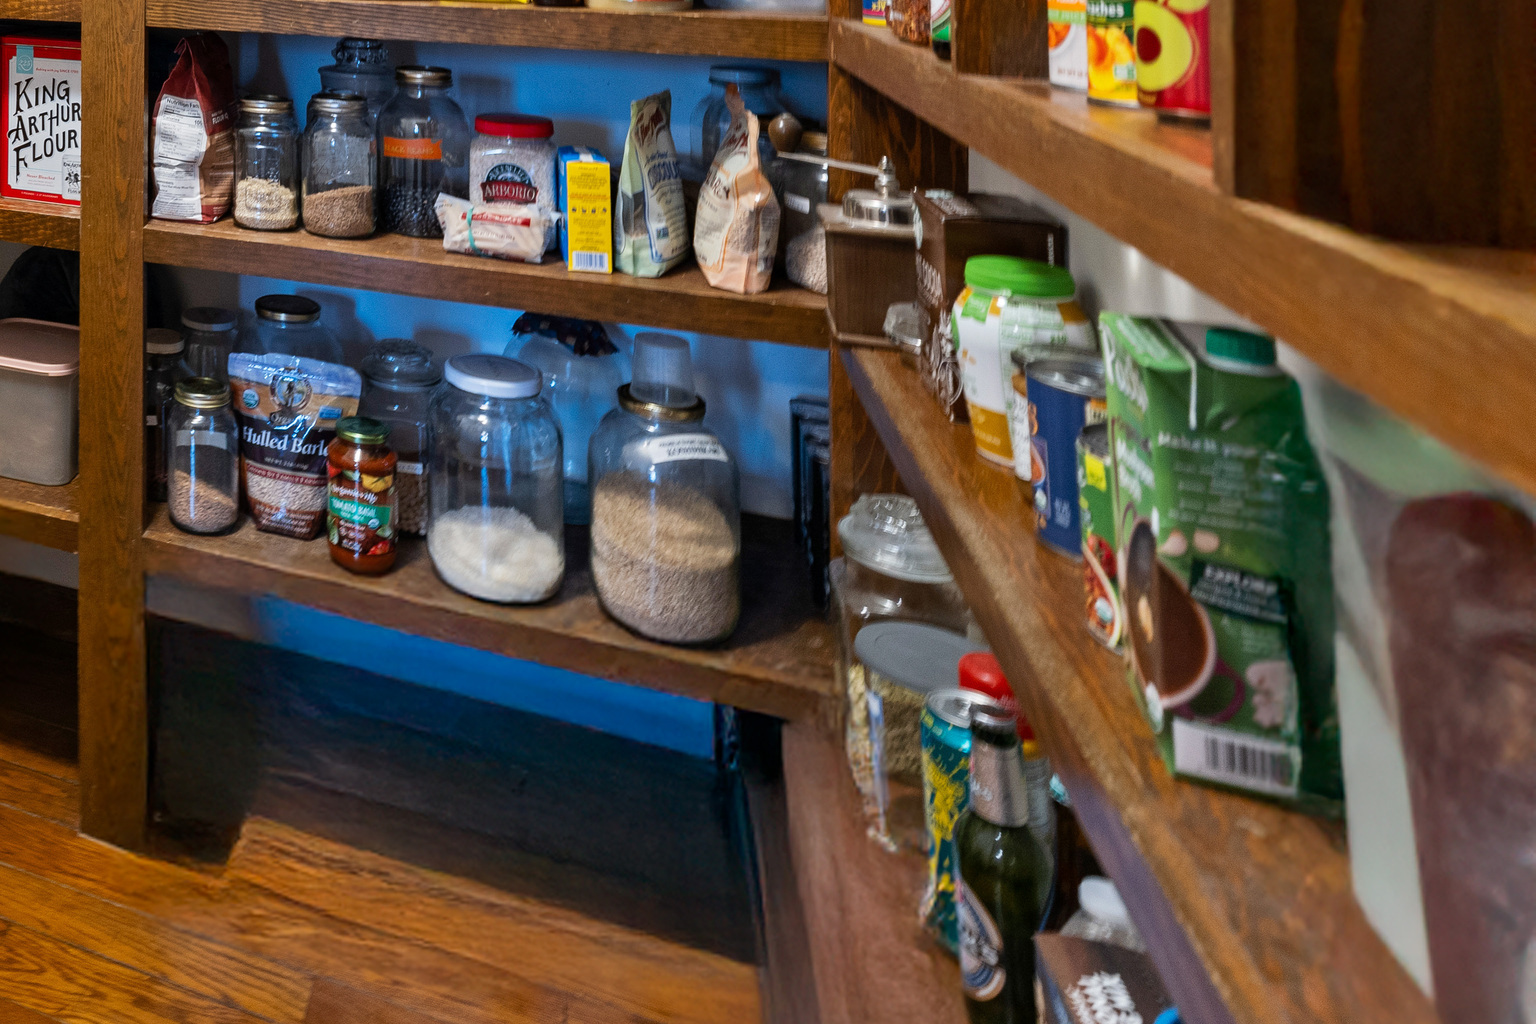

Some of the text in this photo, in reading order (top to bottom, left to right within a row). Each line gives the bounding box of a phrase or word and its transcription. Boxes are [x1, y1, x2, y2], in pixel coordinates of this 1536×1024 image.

[13, 77, 70, 117] KING
[167, 98, 189, 108] Nutrition
[7, 102, 81, 145] ARTHUR
[13, 129, 79, 184] FLOUR
[484, 184, 536, 200] ARBORIO
[243, 426, 328, 457] Hulled Barl
